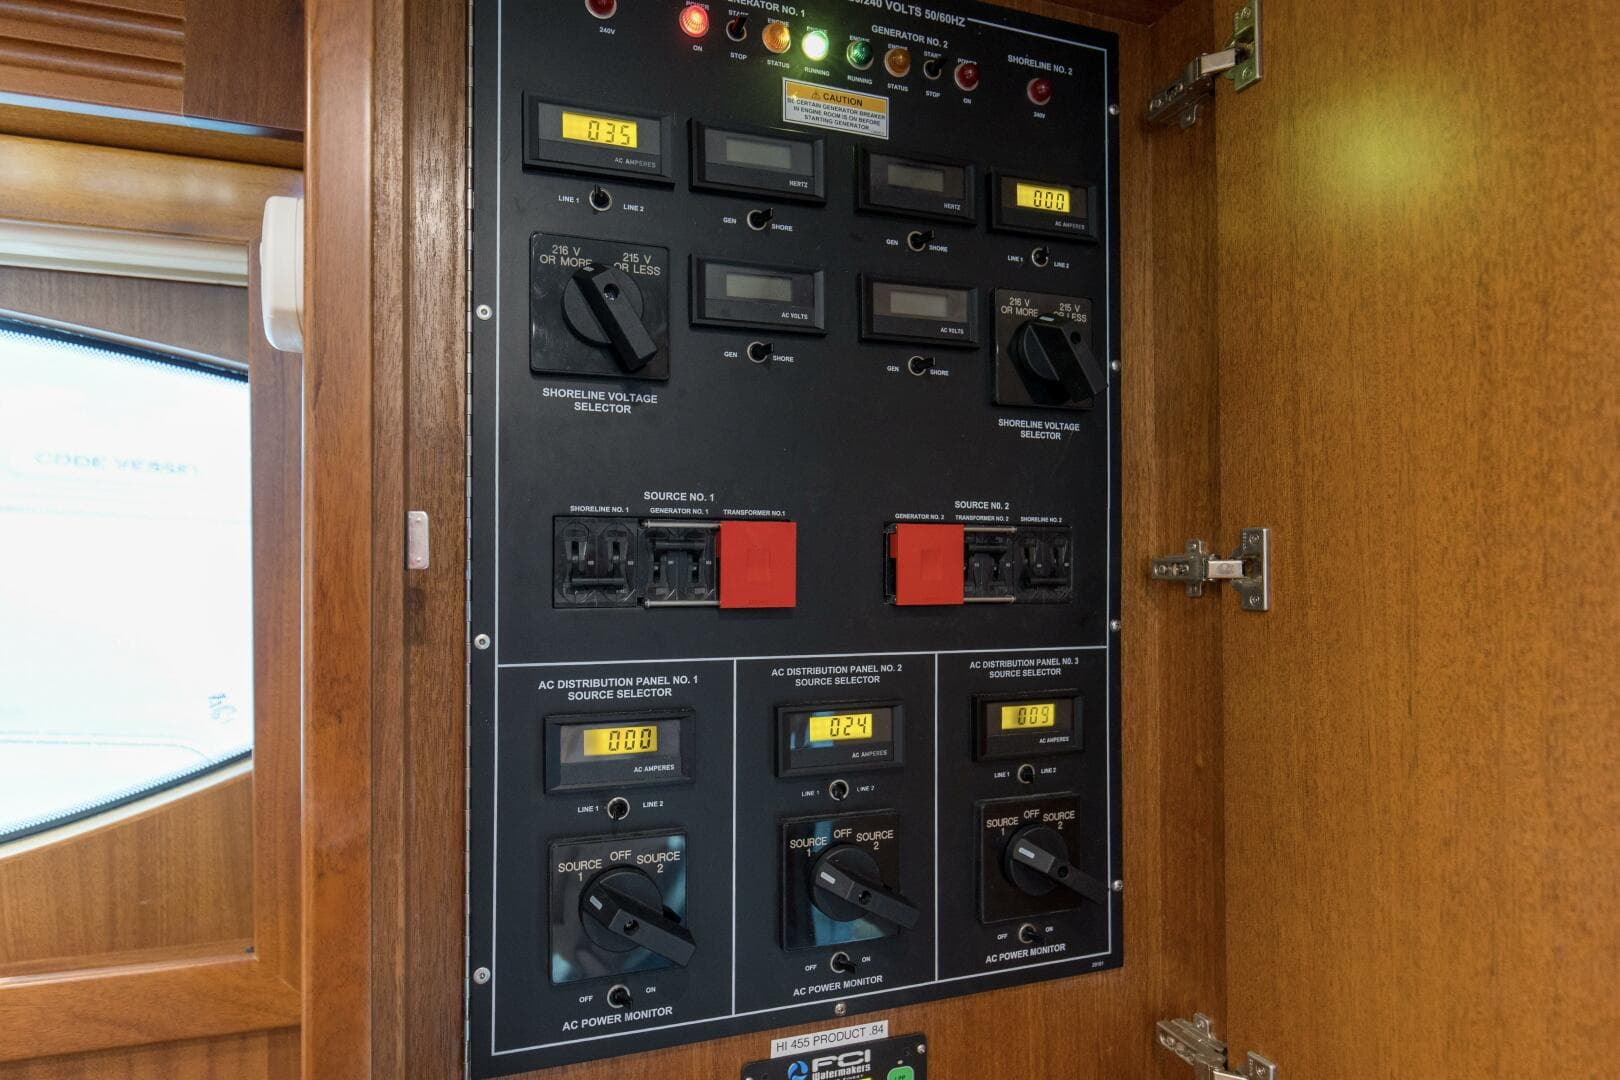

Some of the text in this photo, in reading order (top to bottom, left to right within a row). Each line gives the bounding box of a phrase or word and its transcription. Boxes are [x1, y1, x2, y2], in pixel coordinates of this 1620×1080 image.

[782, 5, 798, 16] NO.
[801, 9, 806, 17] 1
[885, 0, 922, 17] VOLTS
[925, 9, 966, 27] 50/60HZ
[600, 26, 616, 35] 240V
[871, 25, 949, 49] GENERATOR NO. 2
[730, 52, 747, 60] STOP
[767, 59, 789, 69] STATUS
[1007, 54, 1073, 76] SHORELINE NO. 2
[804, 66, 830, 77] RUNNING
[847, 75, 872, 85] RUNNING
[887, 83, 908, 92] STATUS
[823, 92, 862, 107] CAUTION
[925, 90, 940, 98] STOP
[797, 99, 821, 109] CERTAIN
[823, 104, 858, 115] GENERATOR
[859, 110, 886, 120] BREAKER
[800, 107, 822, 116] ENGINE
[823, 110, 841, 119] ROOM
[858, 117, 880, 126] BEFORE
[804, 114, 870, 130] STARTING GENERATOR
[588, 119, 631, 146] 035
[625, 158, 656, 168] AMPERES
[789, 180, 808, 188] HERTZ
[943, 202, 961, 211] HERTZ
[1033, 190, 1065, 211] 000
[771, 223, 793, 232] SHORE
[886, 238, 899, 246] GEN
[552, 244, 581, 257] 216 V
[929, 244, 948, 253] SHORE
[539, 254, 592, 268] OR MORE
[622, 252, 652, 264] 215 V
[633, 264, 661, 276] LESS
[1009, 297, 1030, 307] 216 V
[1059, 303, 1081, 313] 215 V
[791, 312, 808, 320] VOLTS
[1000, 305, 1039, 318] OR MORE
[940, 326, 947, 334] AC
[772, 355, 794, 363] SHORE
[887, 365, 899, 373] GEN
[930, 368, 949, 376] SHORE
[542, 388, 658, 405] SHORELINE VOLTAGE
[574, 401, 632, 414] SELECTOR
[998, 418, 1080, 432] SHORELINE VOLTAGE
[1020, 429, 1062, 441] SELECTOR
[643, 491, 715, 502] SOURCE NO. 1
[569, 505, 610, 513] SHORELINE
[650, 507, 692, 515] GENERATOR
[693, 507, 705, 515] NO.
[954, 500, 1010, 510] SOURCE NO. 2
[723, 509, 771, 517] TRANSFORMER
[970, 657, 1079, 670] AC DISTRIBUTION PANEL NO. 3
[771, 663, 903, 677] AC DISTRIBUTION PANEL NO. 2
[989, 668, 1061, 679] SOURCE SELECTOR
[538, 675, 698, 690] AC DISTRIBUTION PANEL NO. 1
[795, 675, 880, 687] SOURCE SELECTOR
[567, 687, 673, 700] SOURCE SELECTOR
[1017, 706, 1050, 726] 009
[830, 716, 867, 737] 024
[608, 727, 652, 752] 000
[861, 750, 888, 758] AMPERES
[645, 764, 675, 772] AMPERES
[1023, 809, 1040, 819] OFF
[1042, 810, 1075, 822] SOURCE
[986, 816, 1019, 828] SOURCE
[1058, 821, 1063, 830] 2
[833, 828, 852, 839] OFF
[856, 829, 894, 842] SOURCE
[789, 836, 828, 849] SOURCE
[873, 841, 879, 850] 2
[609, 850, 632, 861] OFF
[636, 851, 681, 865] SOURCE
[806, 848, 811, 857] 1
[558, 859, 602, 873] SOURCE
[656, 863, 664, 873] 2
[578, 873, 583, 882] 1
[985, 943, 1066, 964] AC POWER MONITOR
[793, 974, 883, 997] AC POWER MONITOR
[579, 995, 593, 1003] OFF
[562, 1006, 673, 1032] AC POWER MONITOR
[776, 1023, 884, 1052] HI 455 PRODUCT .84
[811, 1049, 871, 1073] FCI
[812, 1064, 871, 1080] Watermakers
